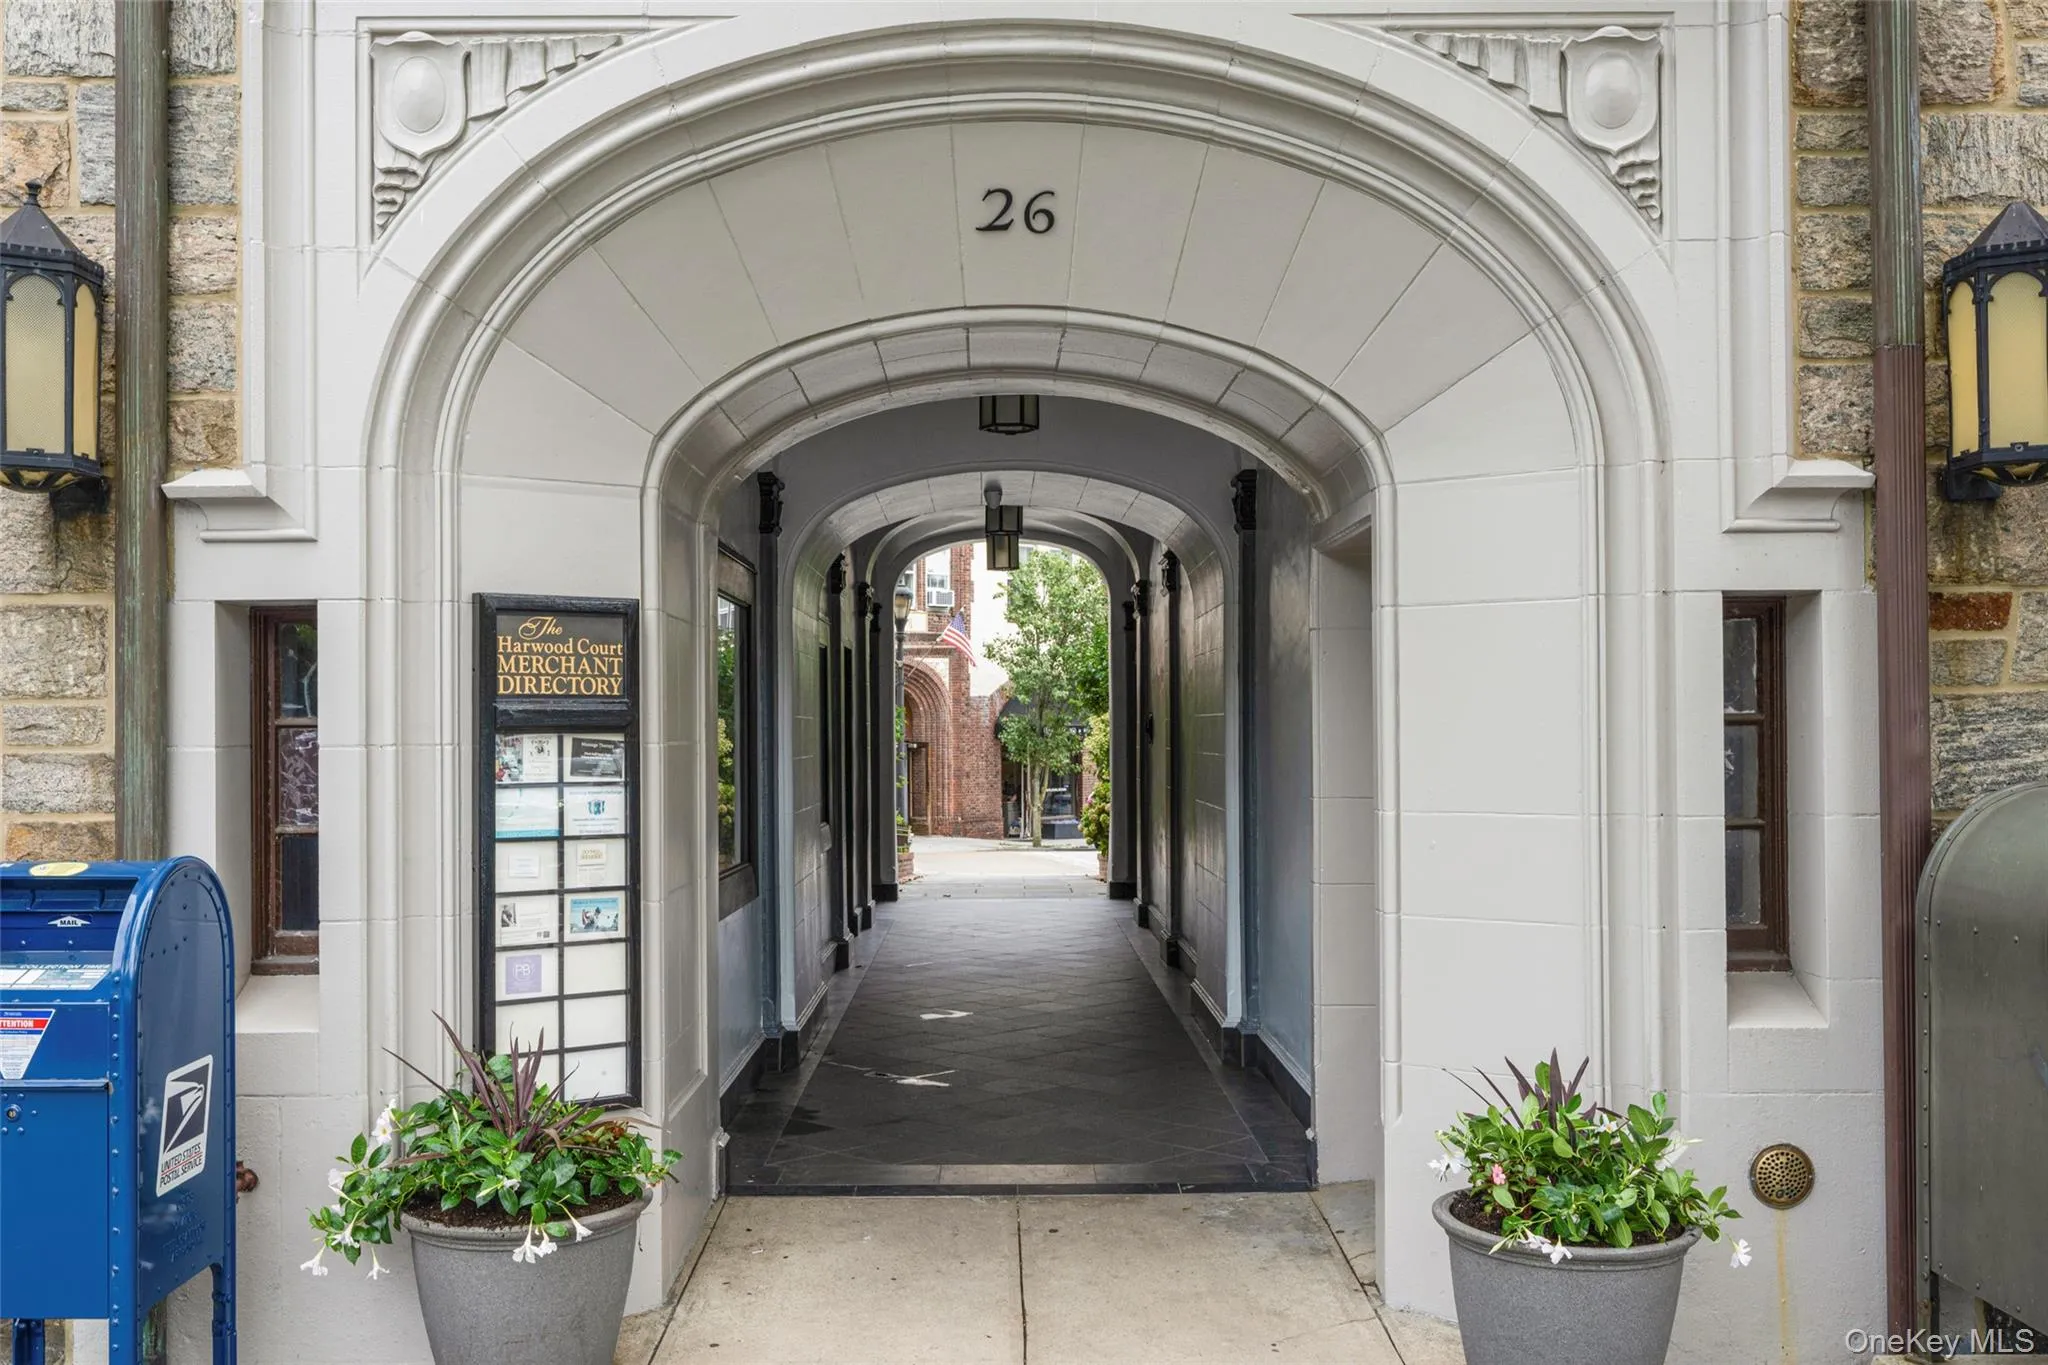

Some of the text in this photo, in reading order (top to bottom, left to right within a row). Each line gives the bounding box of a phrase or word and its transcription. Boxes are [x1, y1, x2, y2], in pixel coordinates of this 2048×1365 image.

[975, 187, 1055, 234] 26
[518, 616, 563, 641] The
[497, 636, 623, 656] Harwood Court
[497, 654, 623, 676] MERCHANT
[497, 675, 623, 696] DIRECTORY
[160, 1142, 202, 1173] UNITED STATES
[159, 1154, 203, 1188] POSTAL SERVICE
